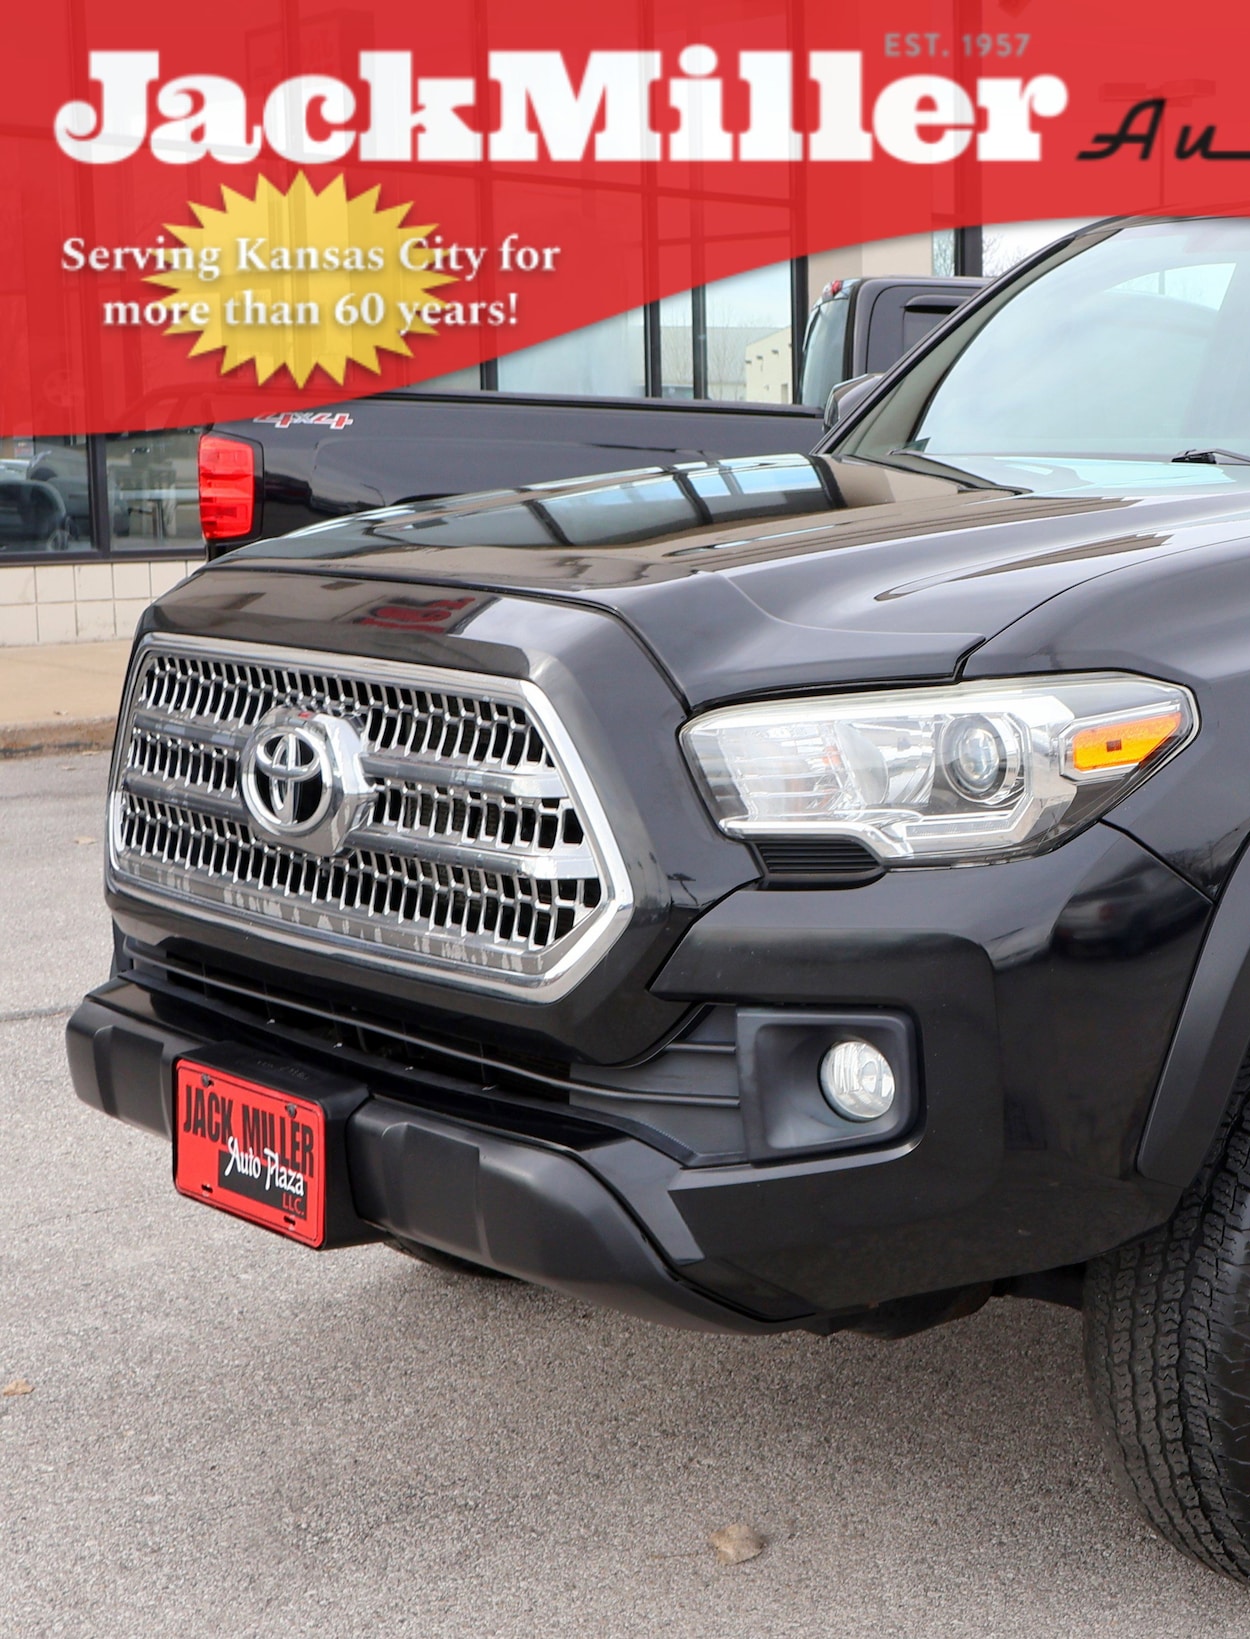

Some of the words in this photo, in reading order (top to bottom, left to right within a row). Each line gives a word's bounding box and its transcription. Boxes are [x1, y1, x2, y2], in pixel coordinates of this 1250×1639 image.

[184, 1085, 234, 1146] JACK
[241, 1103, 314, 1178] MILLER
[224, 1136, 262, 1179] Auto
[264, 1147, 304, 1197] Plaza
